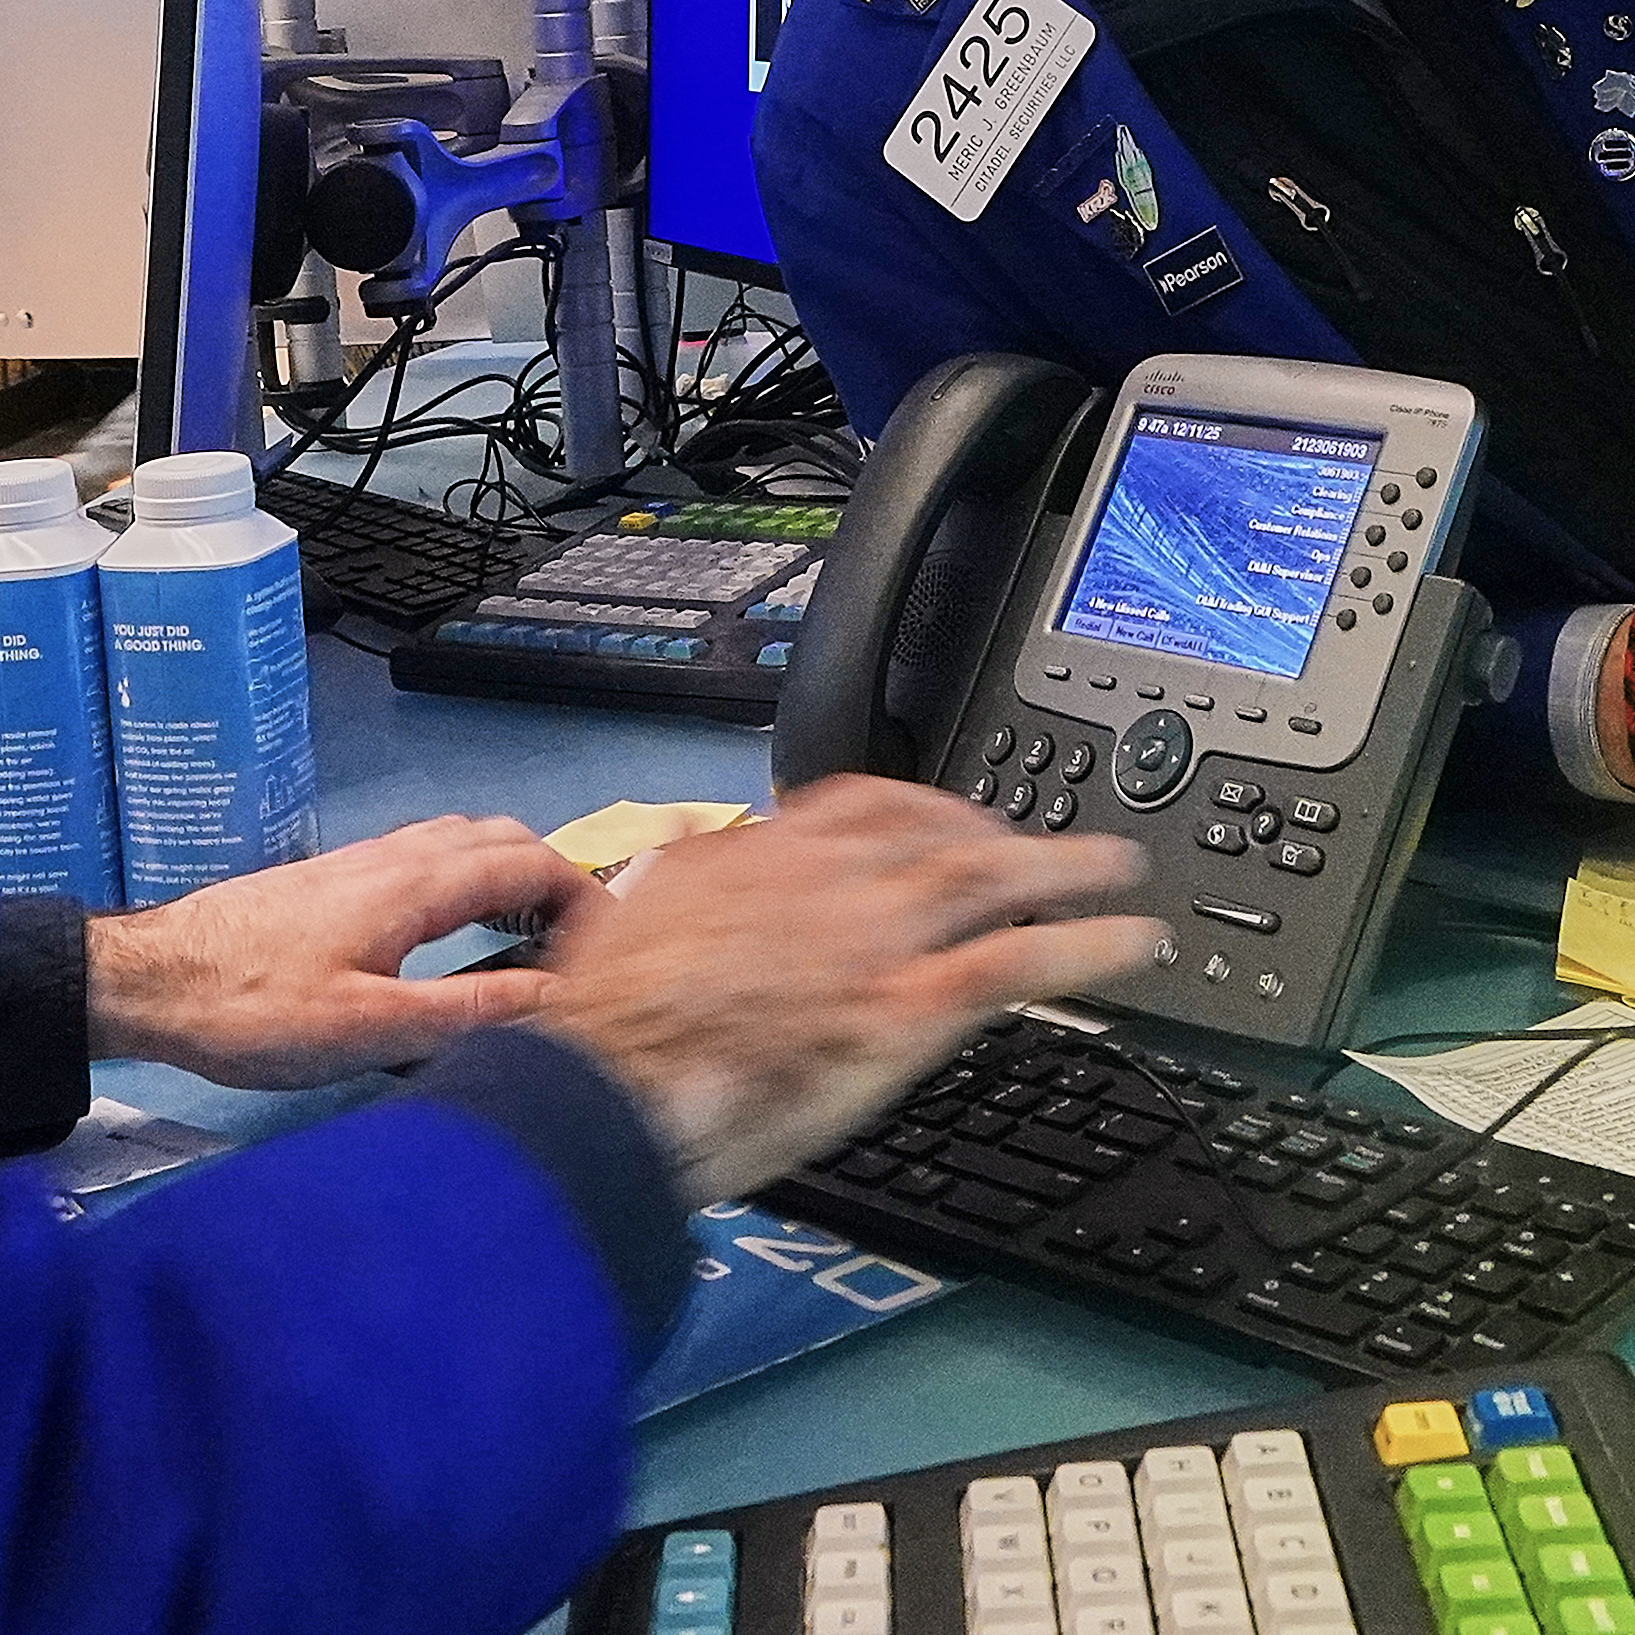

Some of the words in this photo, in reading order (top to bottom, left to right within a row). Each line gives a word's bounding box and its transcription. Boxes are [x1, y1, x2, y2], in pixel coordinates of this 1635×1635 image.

[948, 134, 984, 181] MERIC
[982, 118, 997, 132] J.
[994, 22, 1057, 111] GREENBAUM
[975, 146, 1012, 193] CITADEL
[1009, 72, 1058, 140] SECURITIES
[1055, 44, 1076, 69] LLC
[1164, 251, 1228, 292] Pearson
[1143, 383, 1176, 396] cisco
[1423, 409, 1450, 420] Phone
[1171, 421, 1222, 441] 12/11/25
[1291, 436, 1368, 459] 2123061903
[1312, 485, 1353, 504] Clearing
[1291, 504, 1345, 522] Compliance
[1248, 518, 1293, 536] Customer
[1293, 524, 1338, 542] Relations
[1311, 549, 1331, 564] Ops
[1271, 564, 1324, 583] Supervisor
[1095, 599, 1115, 612] New
[1115, 602, 1147, 618] Missed
[1147, 608, 1170, 622] Calls
[1218, 597, 1253, 616] Trading
[1271, 607, 1310, 626] Support
[113, 624, 135, 637] YOU
[137, 625, 164, 638] JUST
[166, 625, 190, 637] DID
[1075, 618, 1101, 633] Redial
[3, 635, 26, 646] DID
[1116, 625, 1134, 639] New
[1135, 630, 1155, 643] Call
[115, 639, 122, 650] A
[124, 639, 164, 652] GOOD
[164, 639, 206, 652] THING.
[995, 732, 1003, 746] 1
[1030, 741, 1042, 756] 2
[1071, 750, 1083, 765] 3
[976, 778, 986, 793] 4
[1014, 786, 1025, 802] 5
[1053, 796, 1065, 812] 6
[1258, 814, 1271, 833] ?
